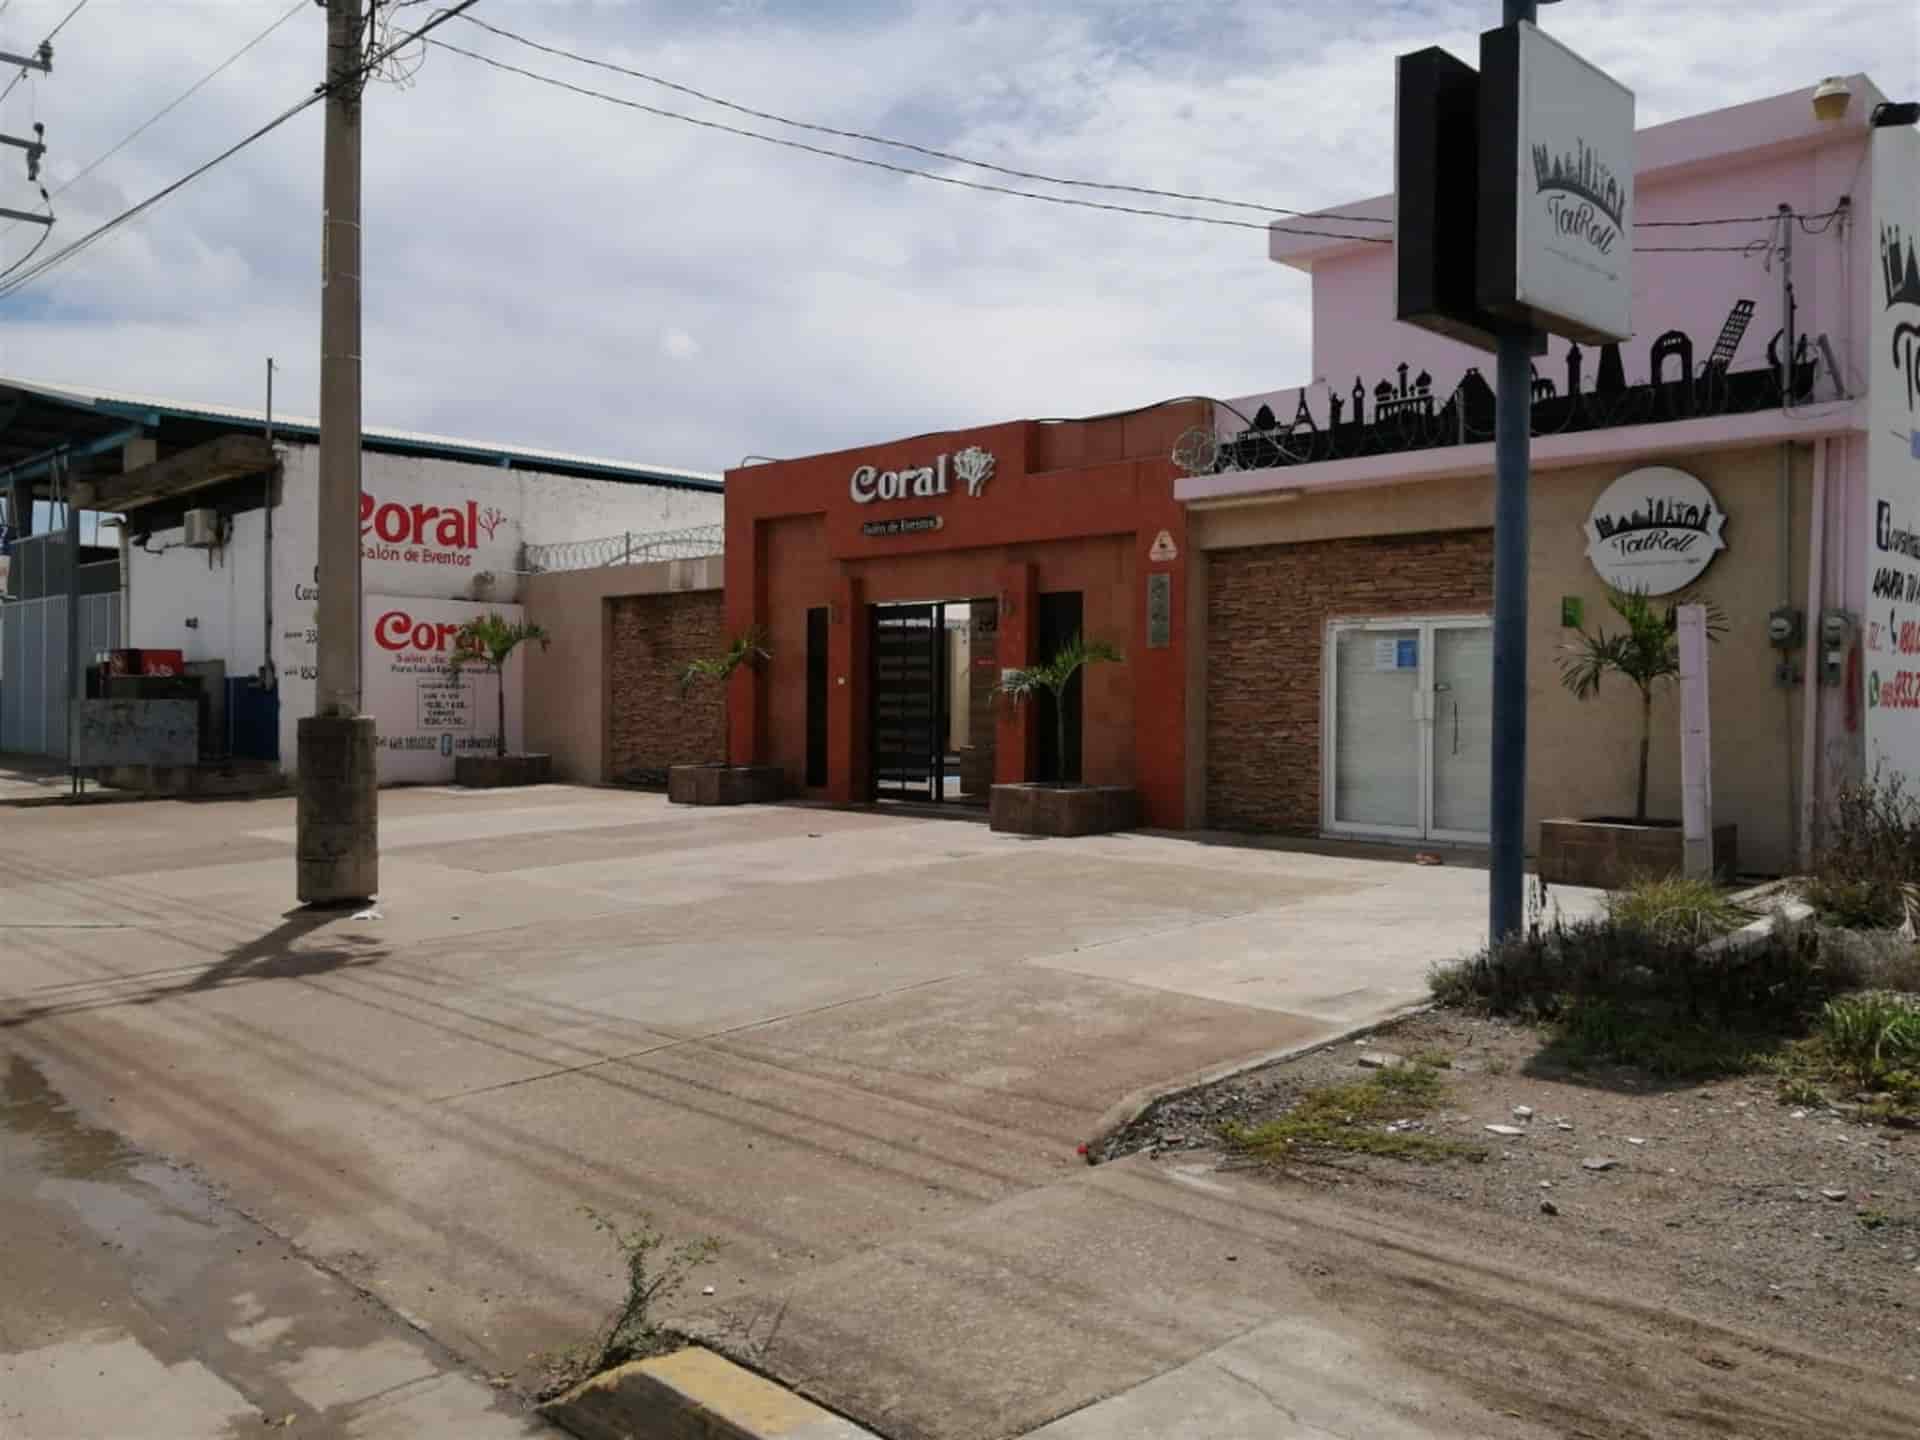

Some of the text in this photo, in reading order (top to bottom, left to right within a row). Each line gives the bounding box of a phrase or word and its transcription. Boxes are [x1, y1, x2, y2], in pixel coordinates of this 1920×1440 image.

[850, 453, 948, 503] Coral
[361, 490, 479, 549] oral
[361, 543, 473, 568] alón de Eventos
